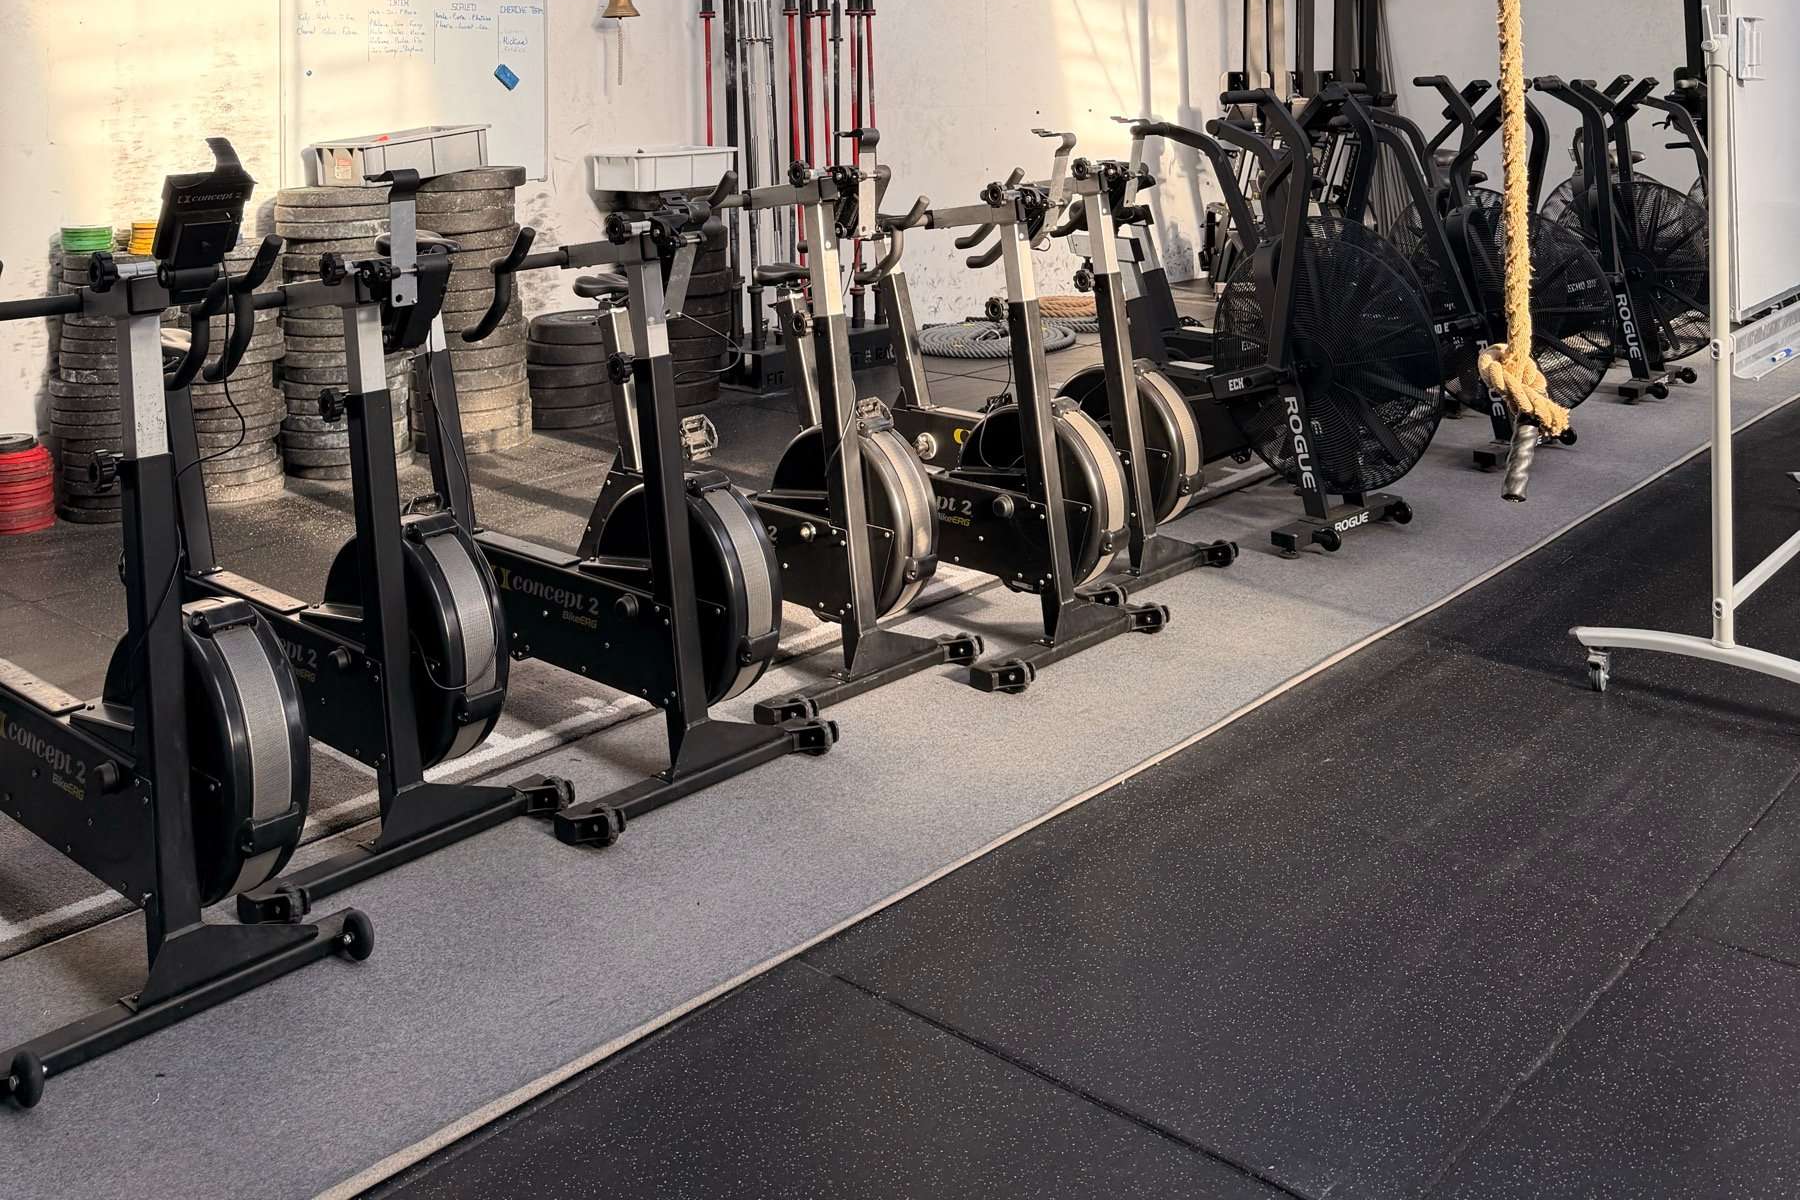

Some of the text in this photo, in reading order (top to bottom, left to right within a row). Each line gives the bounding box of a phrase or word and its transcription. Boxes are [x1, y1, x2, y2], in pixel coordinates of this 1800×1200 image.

[1615, 293, 1642, 360] ROGUE
[1228, 377, 1244, 392] ECH
[1284, 395, 1315, 490] ROGUE
[1334, 511, 1370, 532] ROGUE
[512, 574, 600, 615] concept 2
[7, 721, 86, 784] concept 2
